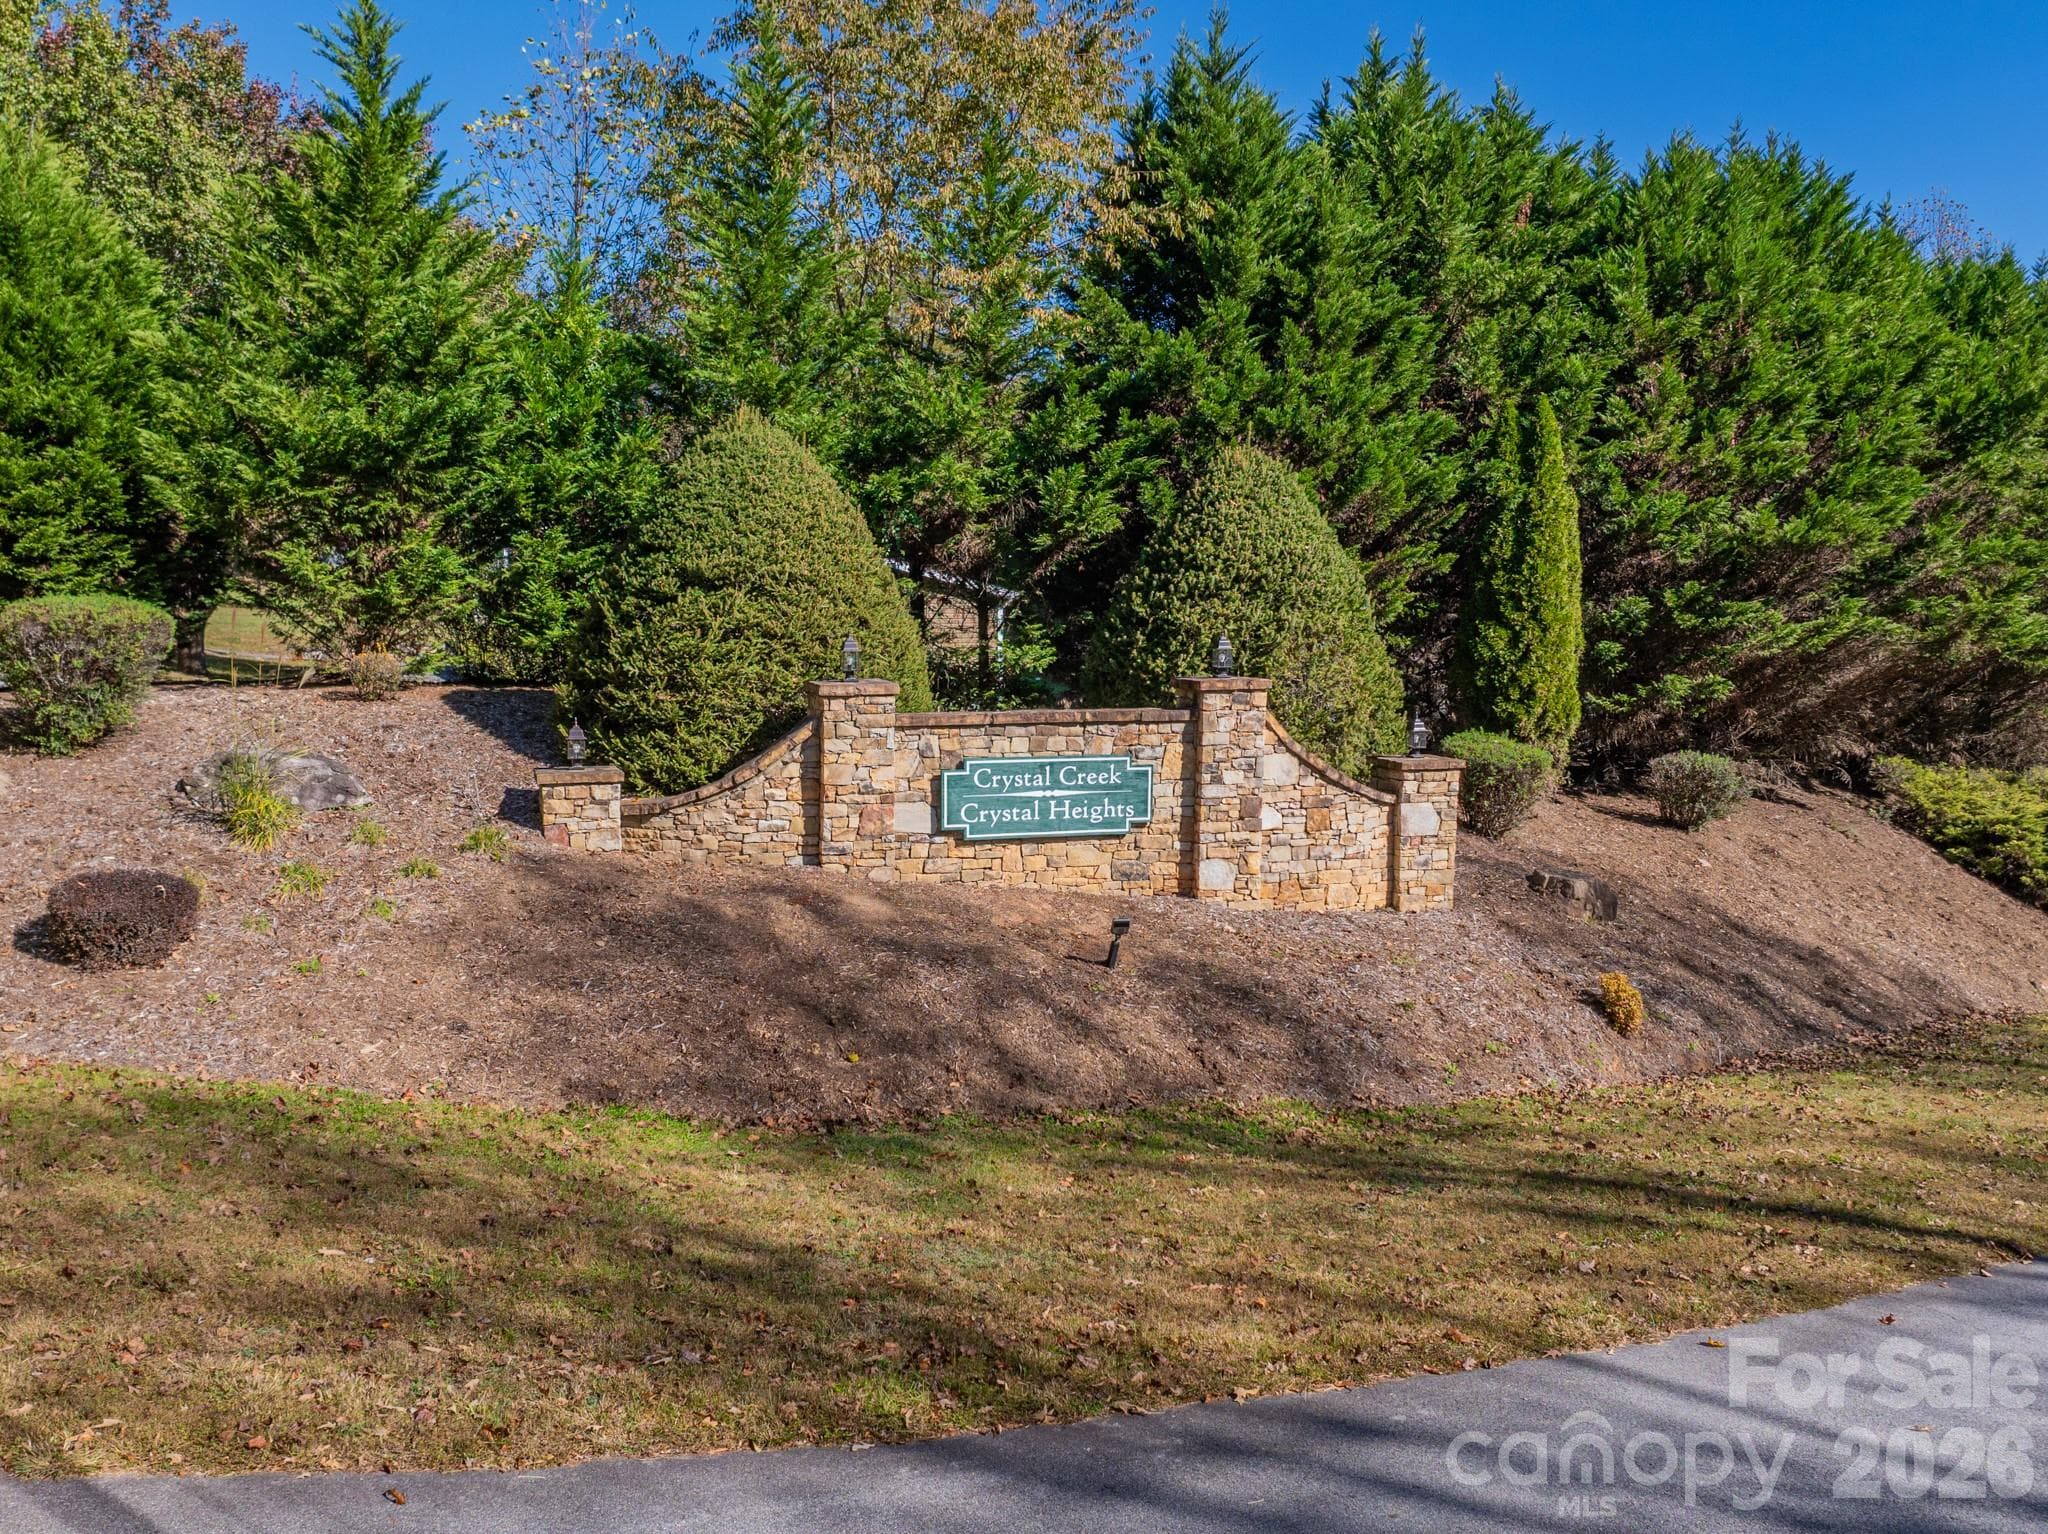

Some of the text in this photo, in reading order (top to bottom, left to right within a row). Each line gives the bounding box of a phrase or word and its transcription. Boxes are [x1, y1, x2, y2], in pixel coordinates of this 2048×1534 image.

[973, 764, 1122, 792] Crystal Creek
[960, 797, 1135, 828] Crystal Heights
